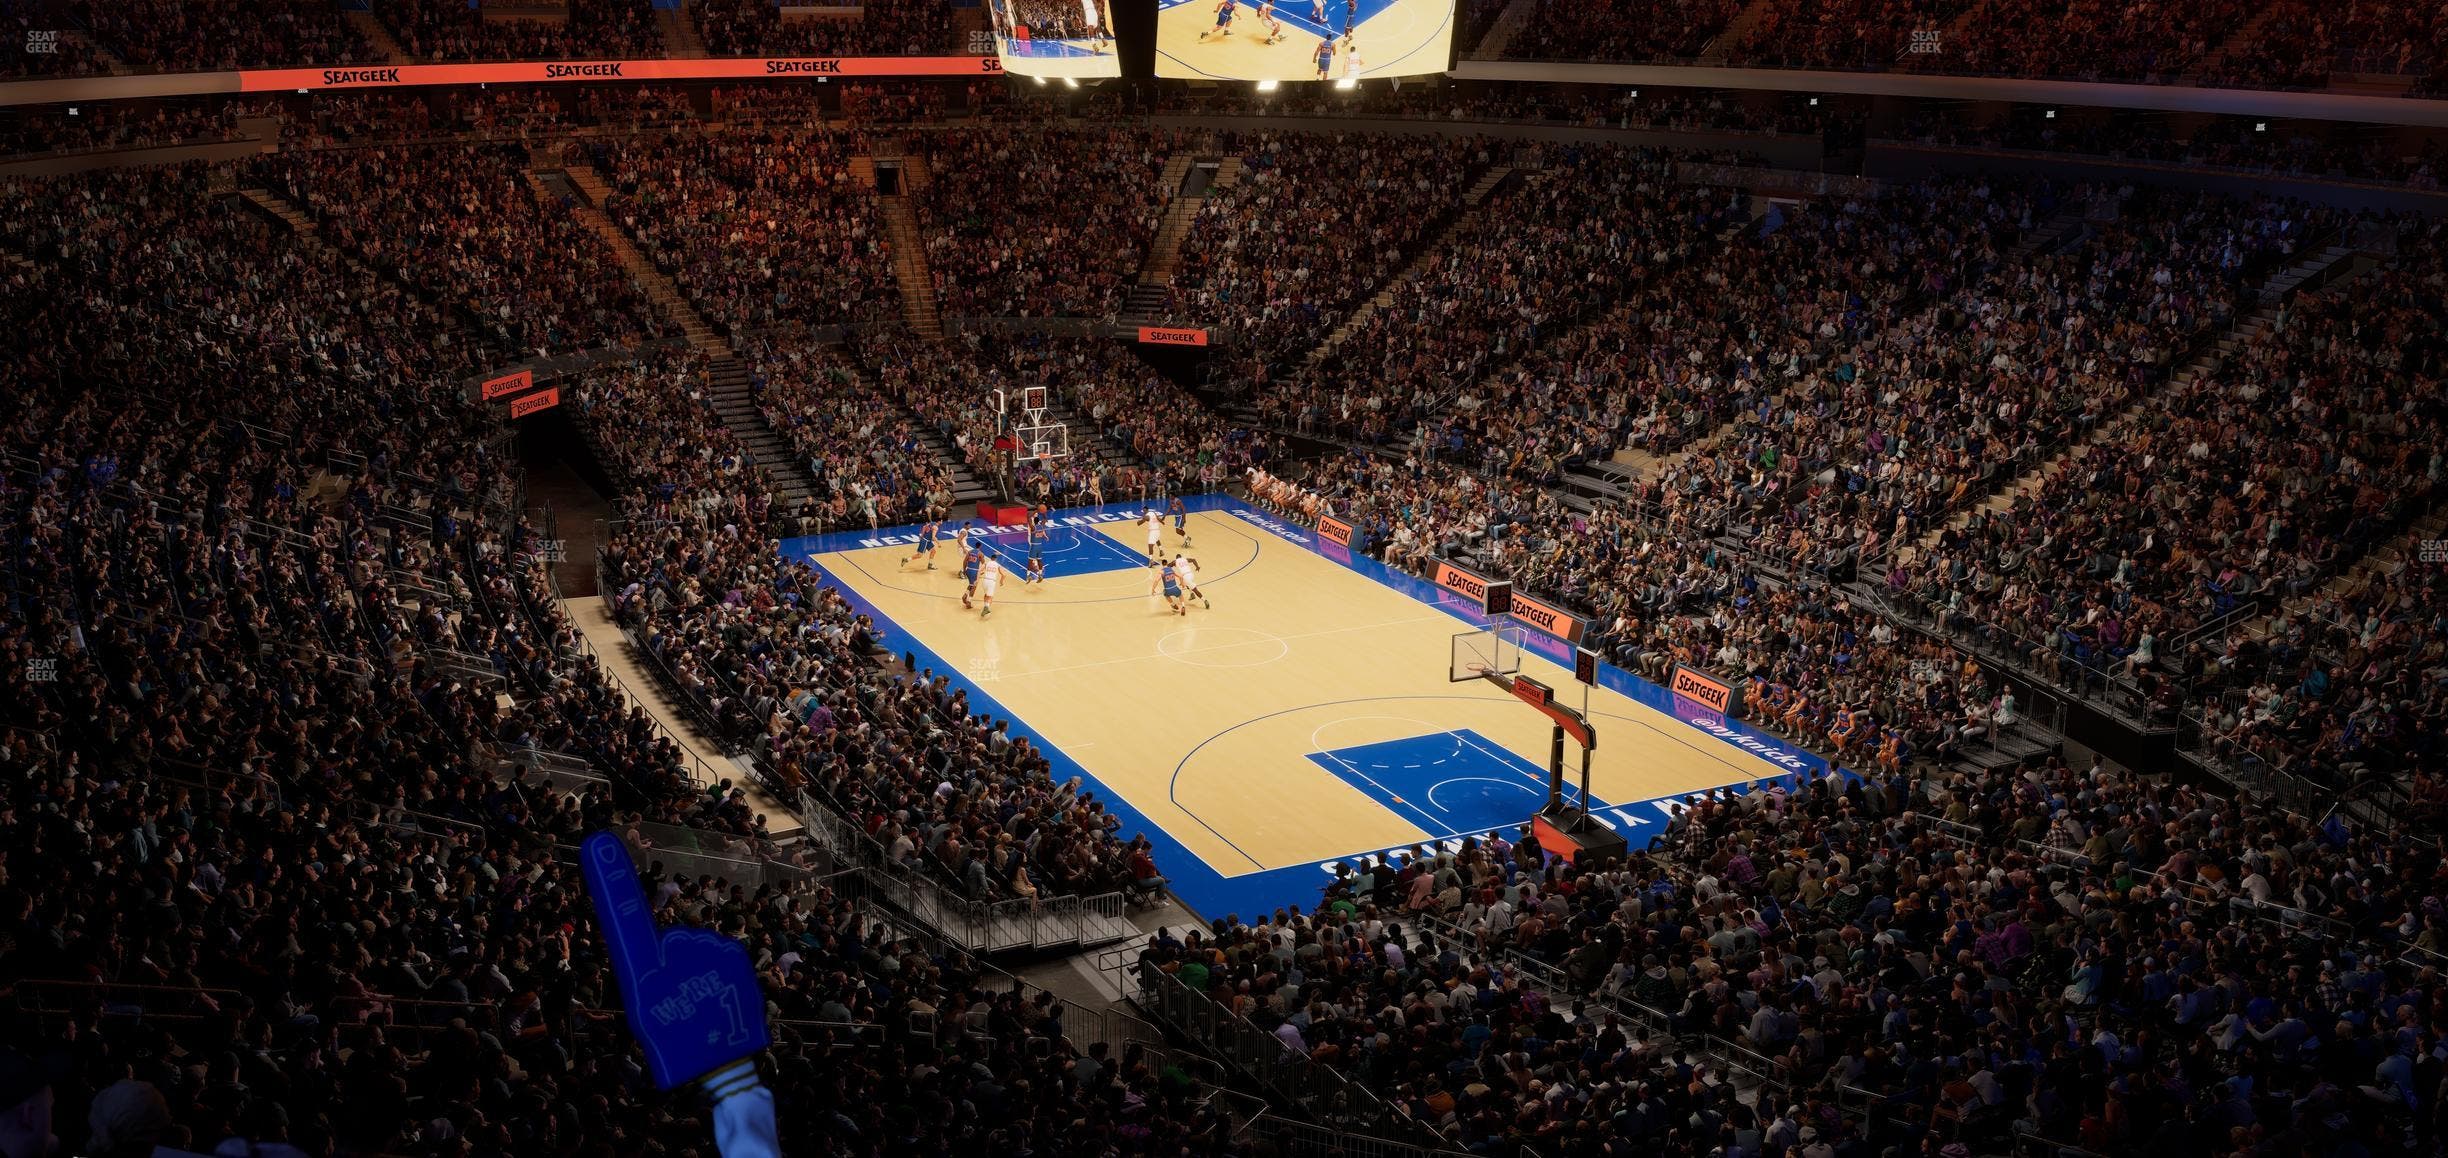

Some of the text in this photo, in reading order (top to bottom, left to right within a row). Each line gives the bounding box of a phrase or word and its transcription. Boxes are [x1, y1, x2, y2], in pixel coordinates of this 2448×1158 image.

[546, 63, 622, 78] SEATGEEK
[766, 59, 841, 74] SEATGEEK
[323, 68, 400, 85] SEATGEEK
[1150, 331, 1196, 343] SEATGEEK
[490, 376, 524, 395] SEATGEEK
[519, 394, 551, 413] SEATGEEK
[1319, 519, 1350, 543] SEATGEEK
[1511, 597, 1557, 631] SEATGEEK
[1518, 682, 1541, 699] SEATGEEK
[1677, 674, 1726, 708] SEATGEEK
[1691, 718, 1808, 768] @nyknicks
